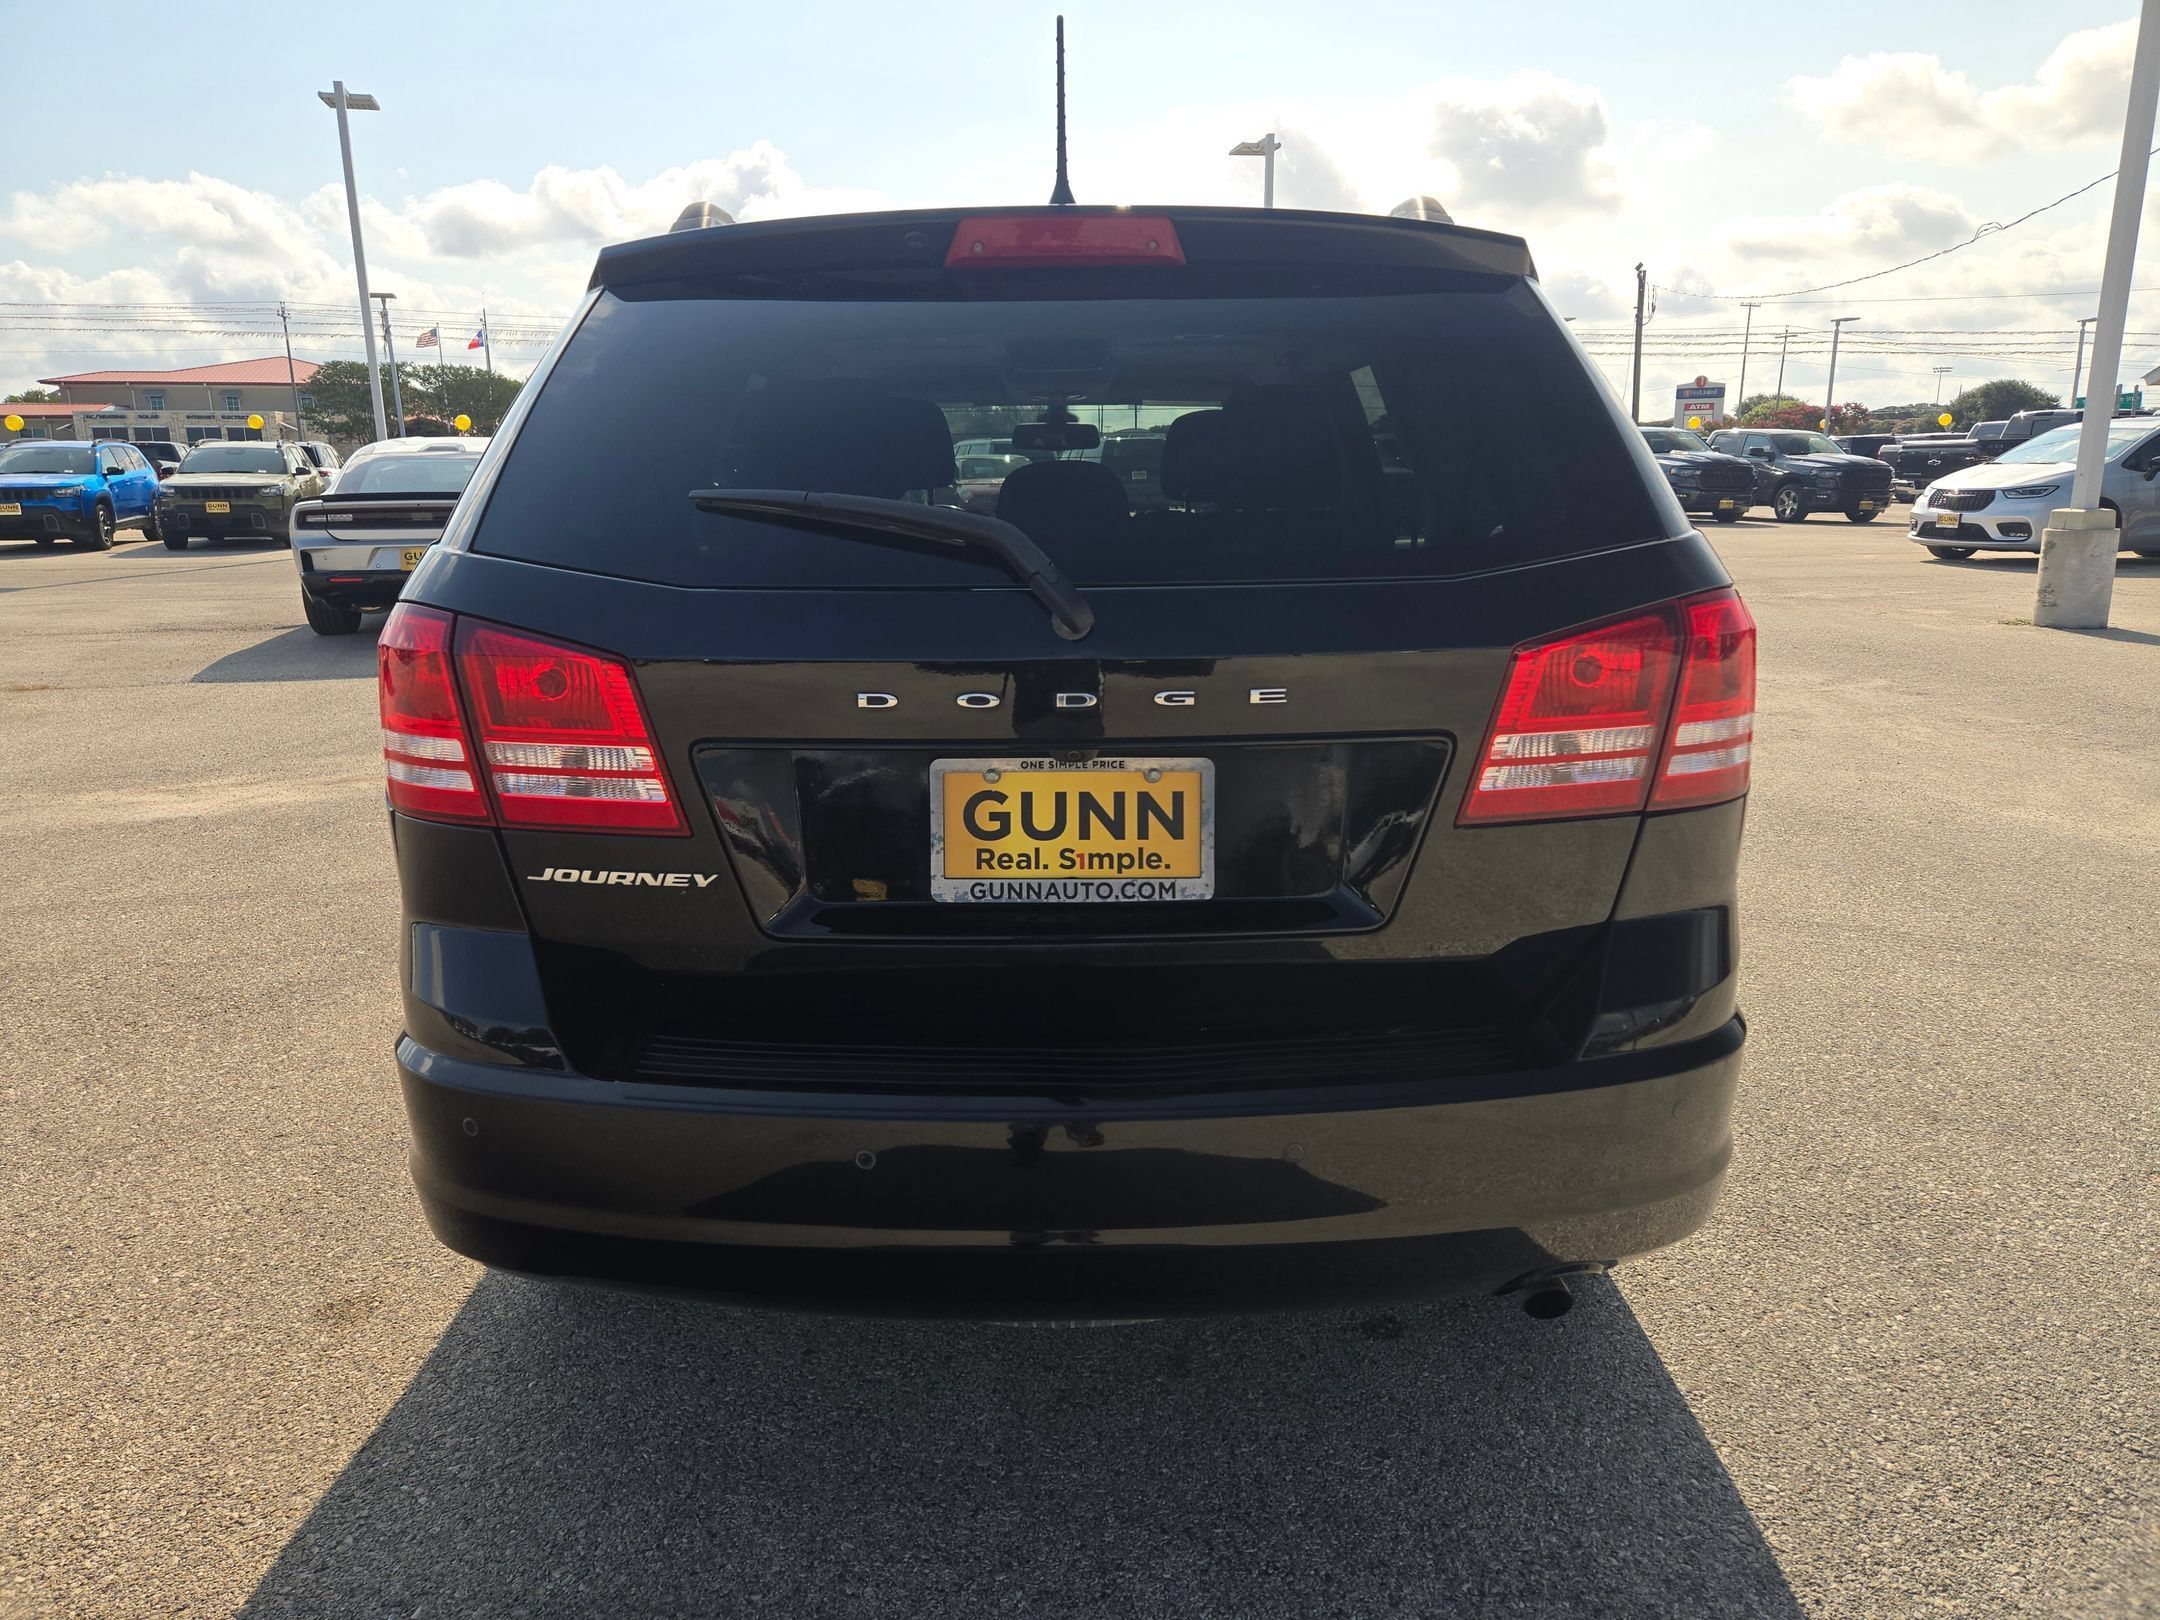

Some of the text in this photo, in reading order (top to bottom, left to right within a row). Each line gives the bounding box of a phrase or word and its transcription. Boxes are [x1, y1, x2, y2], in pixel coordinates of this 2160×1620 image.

[857, 688, 1287, 709] DODGE
[1020, 761, 1125, 769] ONE SIMPLE PRICE
[963, 790, 1184, 841] GUNN
[976, 848, 1049, 870] Real.
[527, 868, 719, 887] JOURNEY
[970, 881, 1177, 900] GUNNAUTO.COM
